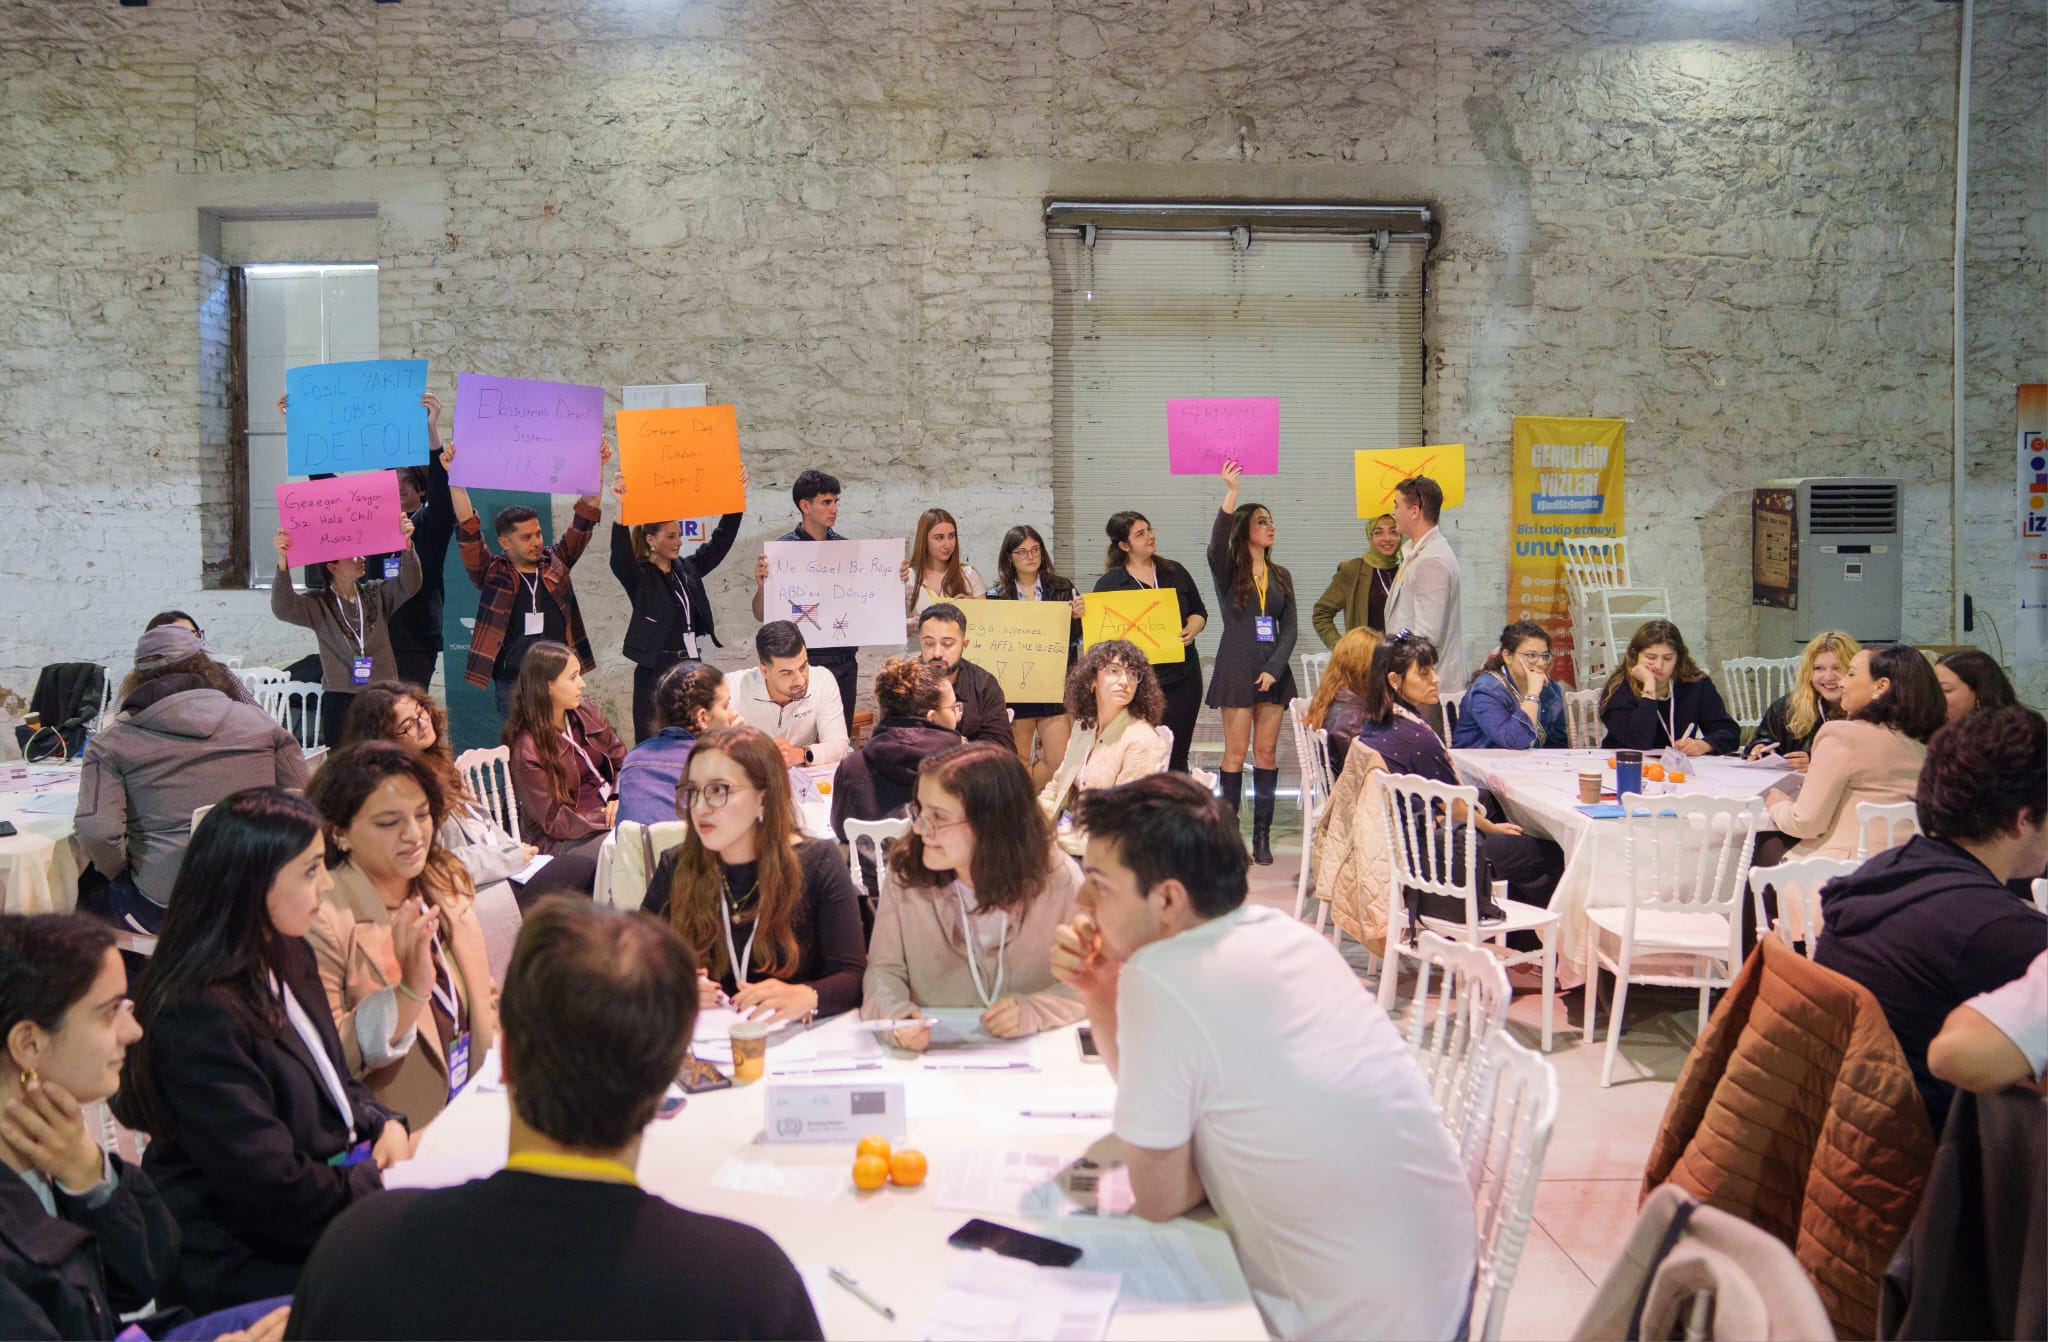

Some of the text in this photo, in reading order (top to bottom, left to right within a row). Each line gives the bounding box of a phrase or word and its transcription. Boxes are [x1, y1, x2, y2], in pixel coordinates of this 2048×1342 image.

[363, 369, 416, 391] YAKIT
[305, 422, 420, 466] DEFOL
[285, 492, 341, 511] Gezegen
[1517, 523, 1616, 537] Bizi takip etmeyi
[777, 560, 796, 573] Ne
[833, 584, 876, 604] Dünya
